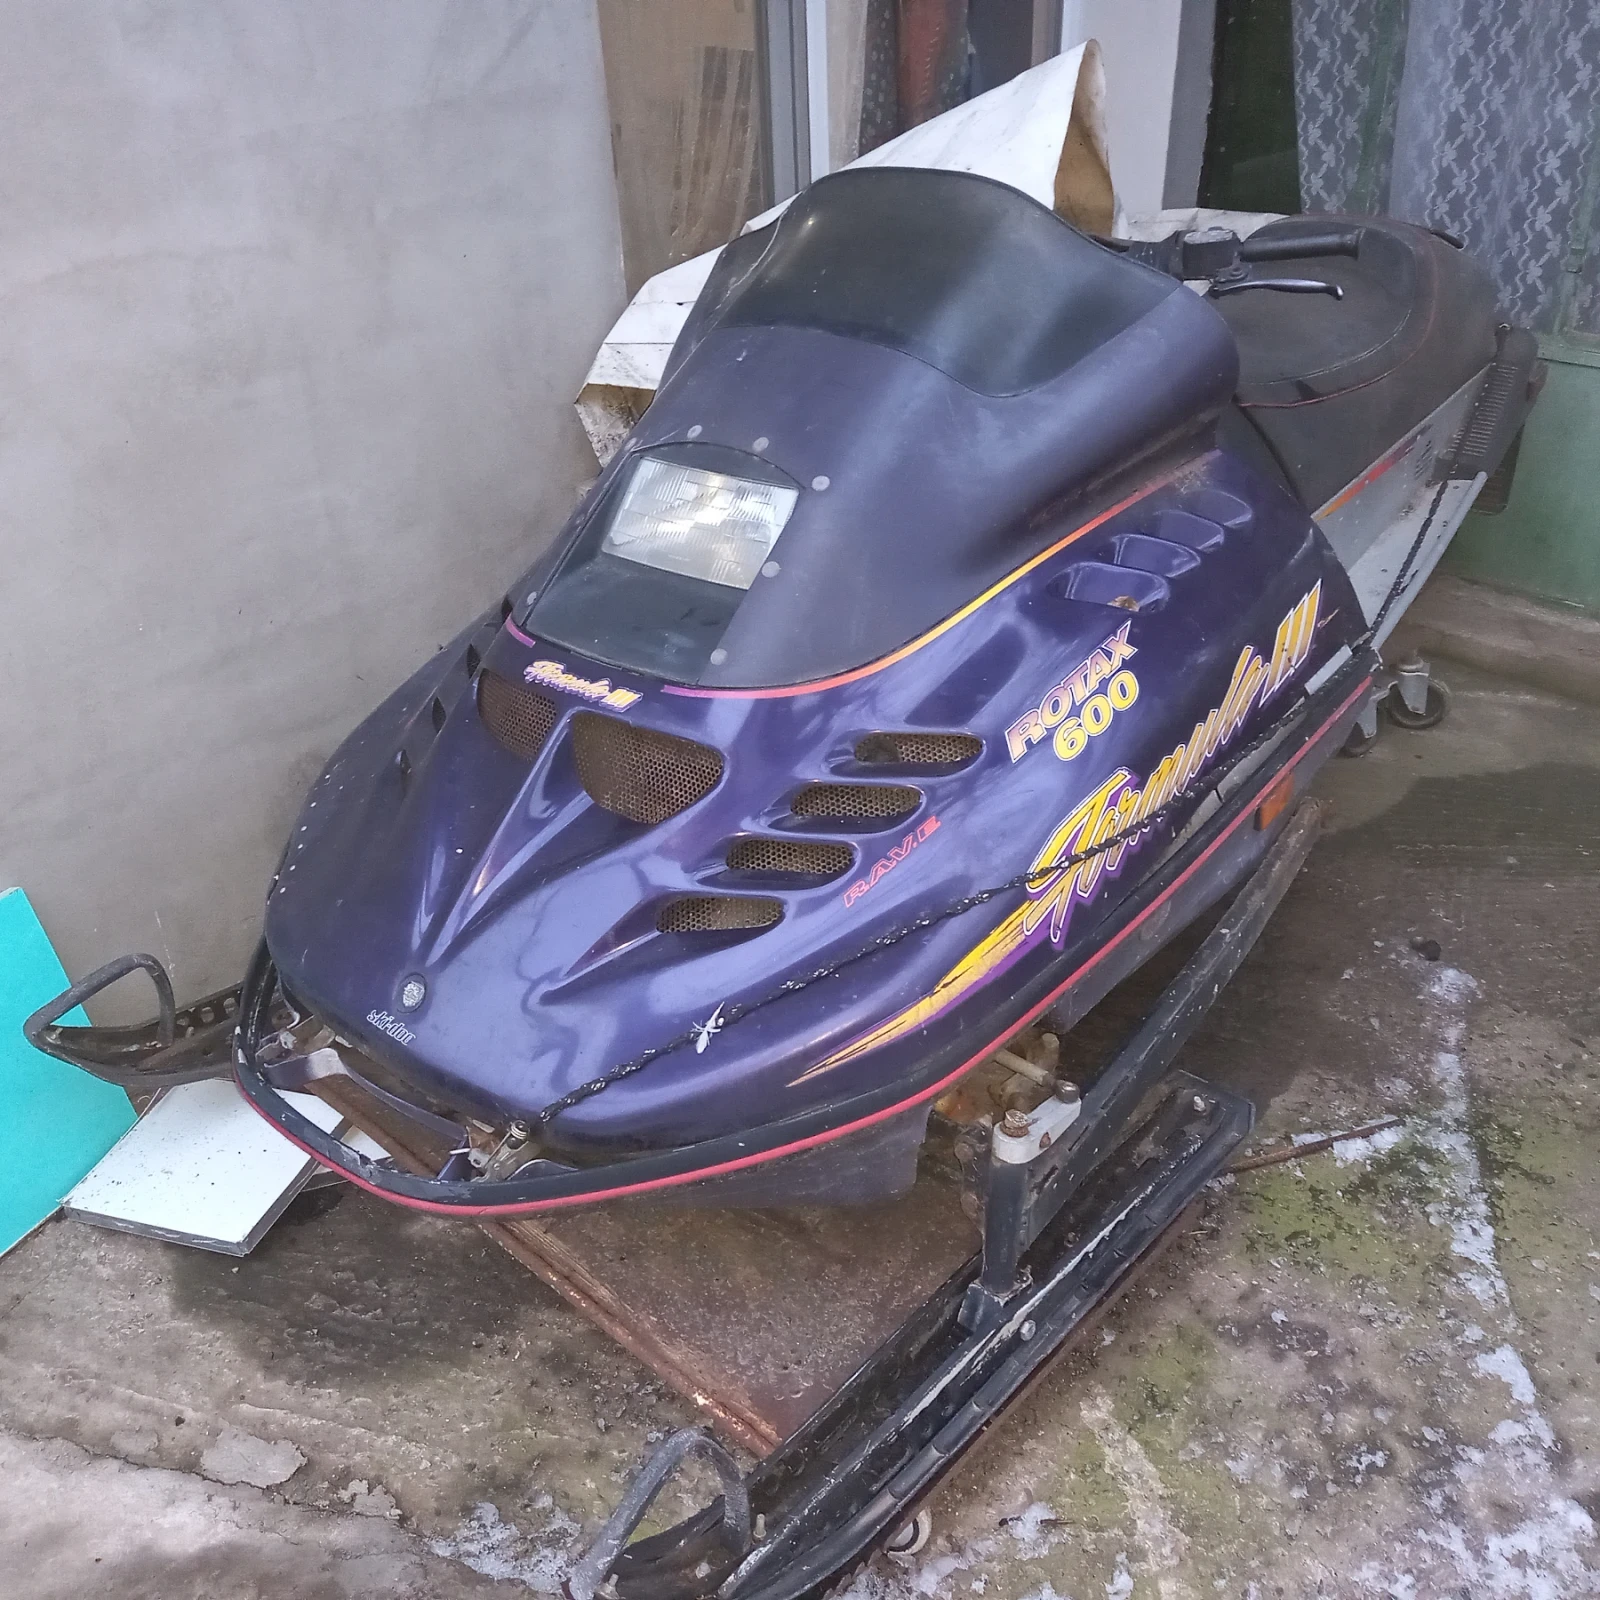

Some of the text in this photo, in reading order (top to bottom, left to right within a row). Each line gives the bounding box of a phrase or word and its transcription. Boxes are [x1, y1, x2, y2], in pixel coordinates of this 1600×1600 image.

[1005, 618, 1138, 763] ROTAX
[1053, 669, 1139, 761] 600
[1024, 645, 1269, 943] Formula
